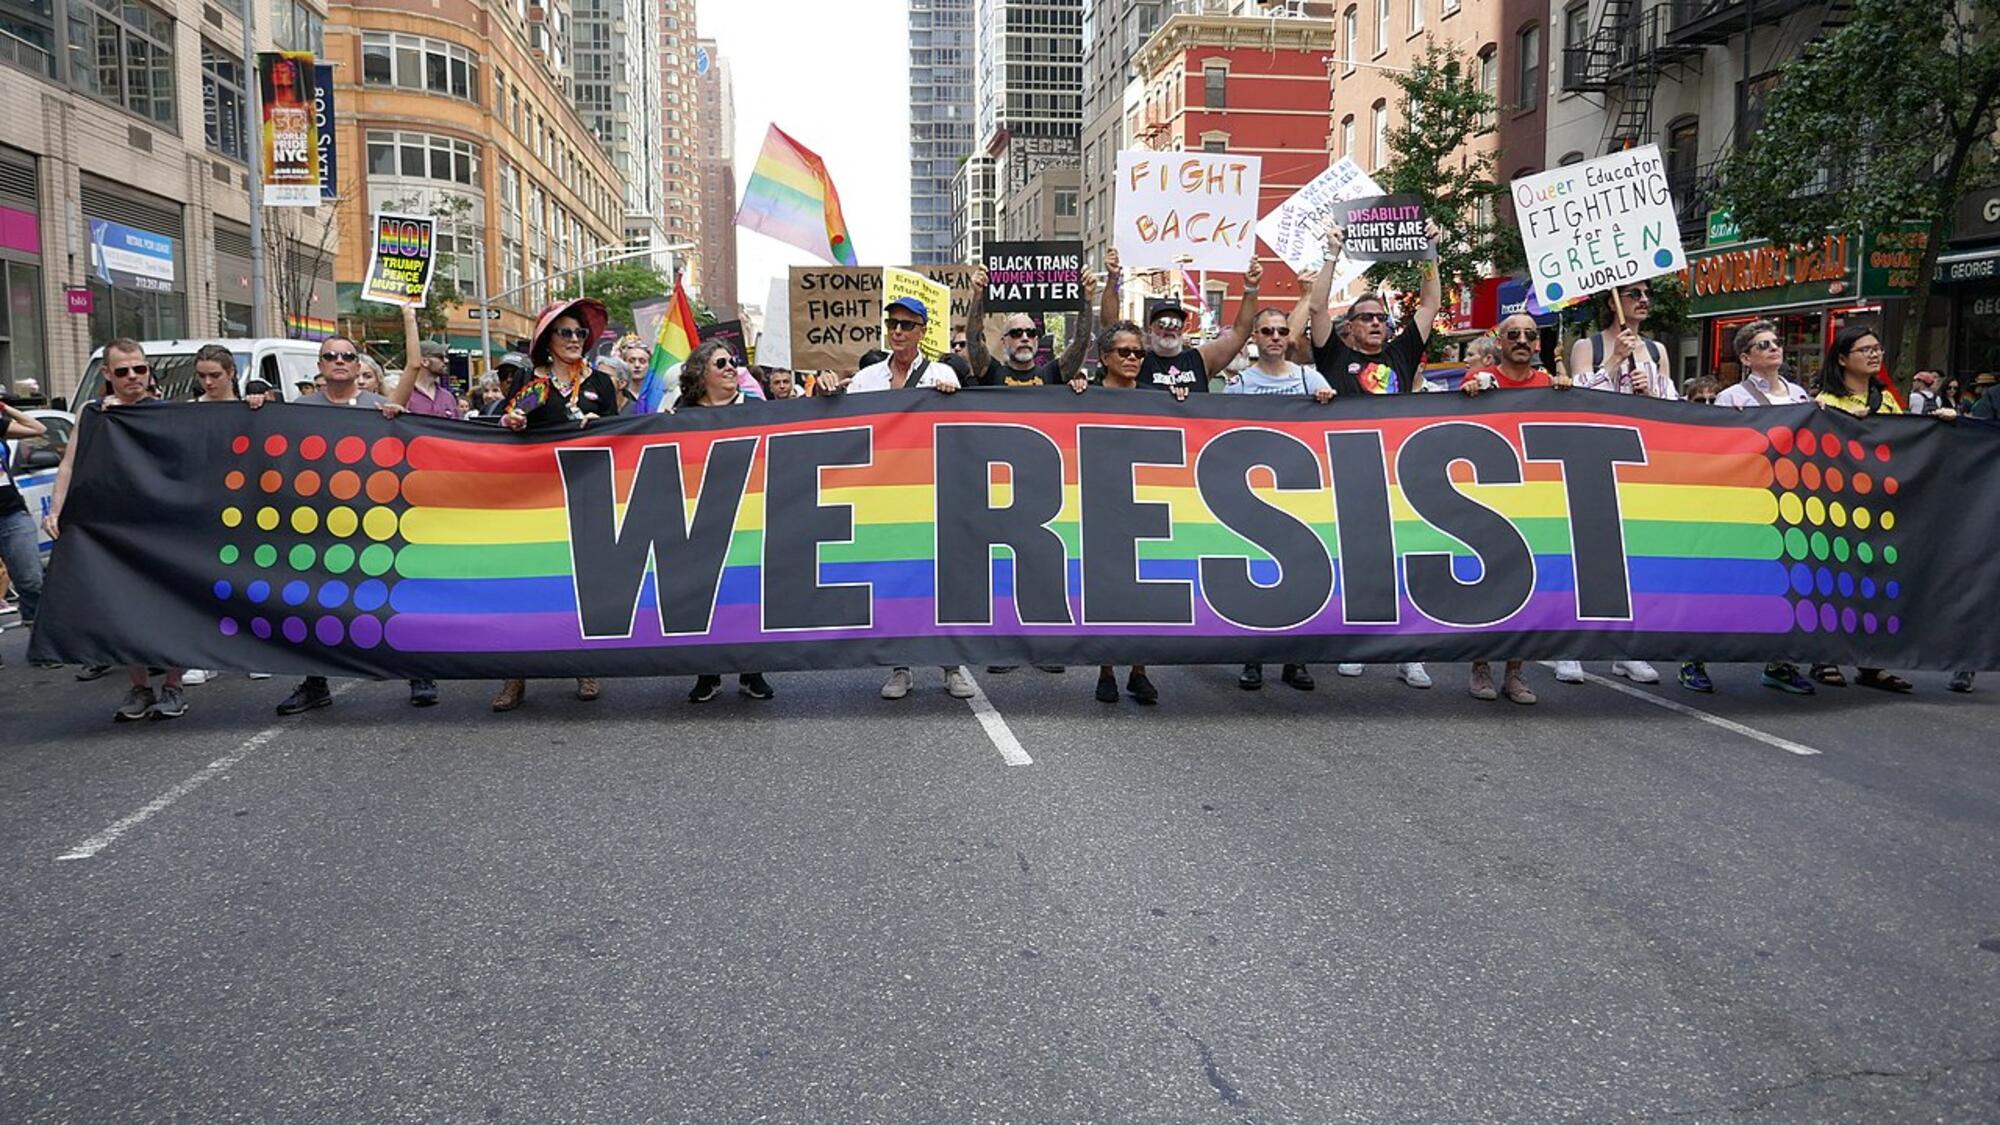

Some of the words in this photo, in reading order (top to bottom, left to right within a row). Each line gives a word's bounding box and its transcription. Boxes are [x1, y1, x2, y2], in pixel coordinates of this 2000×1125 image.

[273, 149, 308, 162] NYC
[1130, 160, 1247, 195] FIGHT
[1585, 156, 1661, 187] Educator
[1347, 205, 1420, 222] DISABILITY
[1528, 173, 1670, 239] FIGHTING
[380, 218, 430, 258] NO!
[1135, 209, 1251, 249] BACK!
[1346, 222, 1395, 238] RIGHTS
[1397, 221, 1423, 236] ARE
[1573, 227, 1602, 246] for
[1612, 223, 1621, 233] a
[1345, 238, 1379, 253] CIVIL
[1380, 236, 1428, 252] RIGHTS
[1538, 221, 1662, 279] GREEN
[989, 255, 1032, 271] BLACK
[1035, 255, 1079, 271] TRANS
[1695, 246, 1788, 297] GOURMET
[1951, 260, 1994, 279] GEORGE
[371, 278, 404, 292] MUST
[382, 269, 420, 282] PENCE
[895, 274, 920, 286] End
[990, 271, 1044, 283] WOMEN'S
[1047, 271, 1078, 282] LIVES
[1577, 260, 1639, 291] WORLD
[988, 282, 1079, 301] MATTER
[807, 299, 871, 321] FIGHT
[806, 323, 847, 345] GAY
[554, 425, 874, 639] WE
[934, 421, 1648, 630] RESIST
